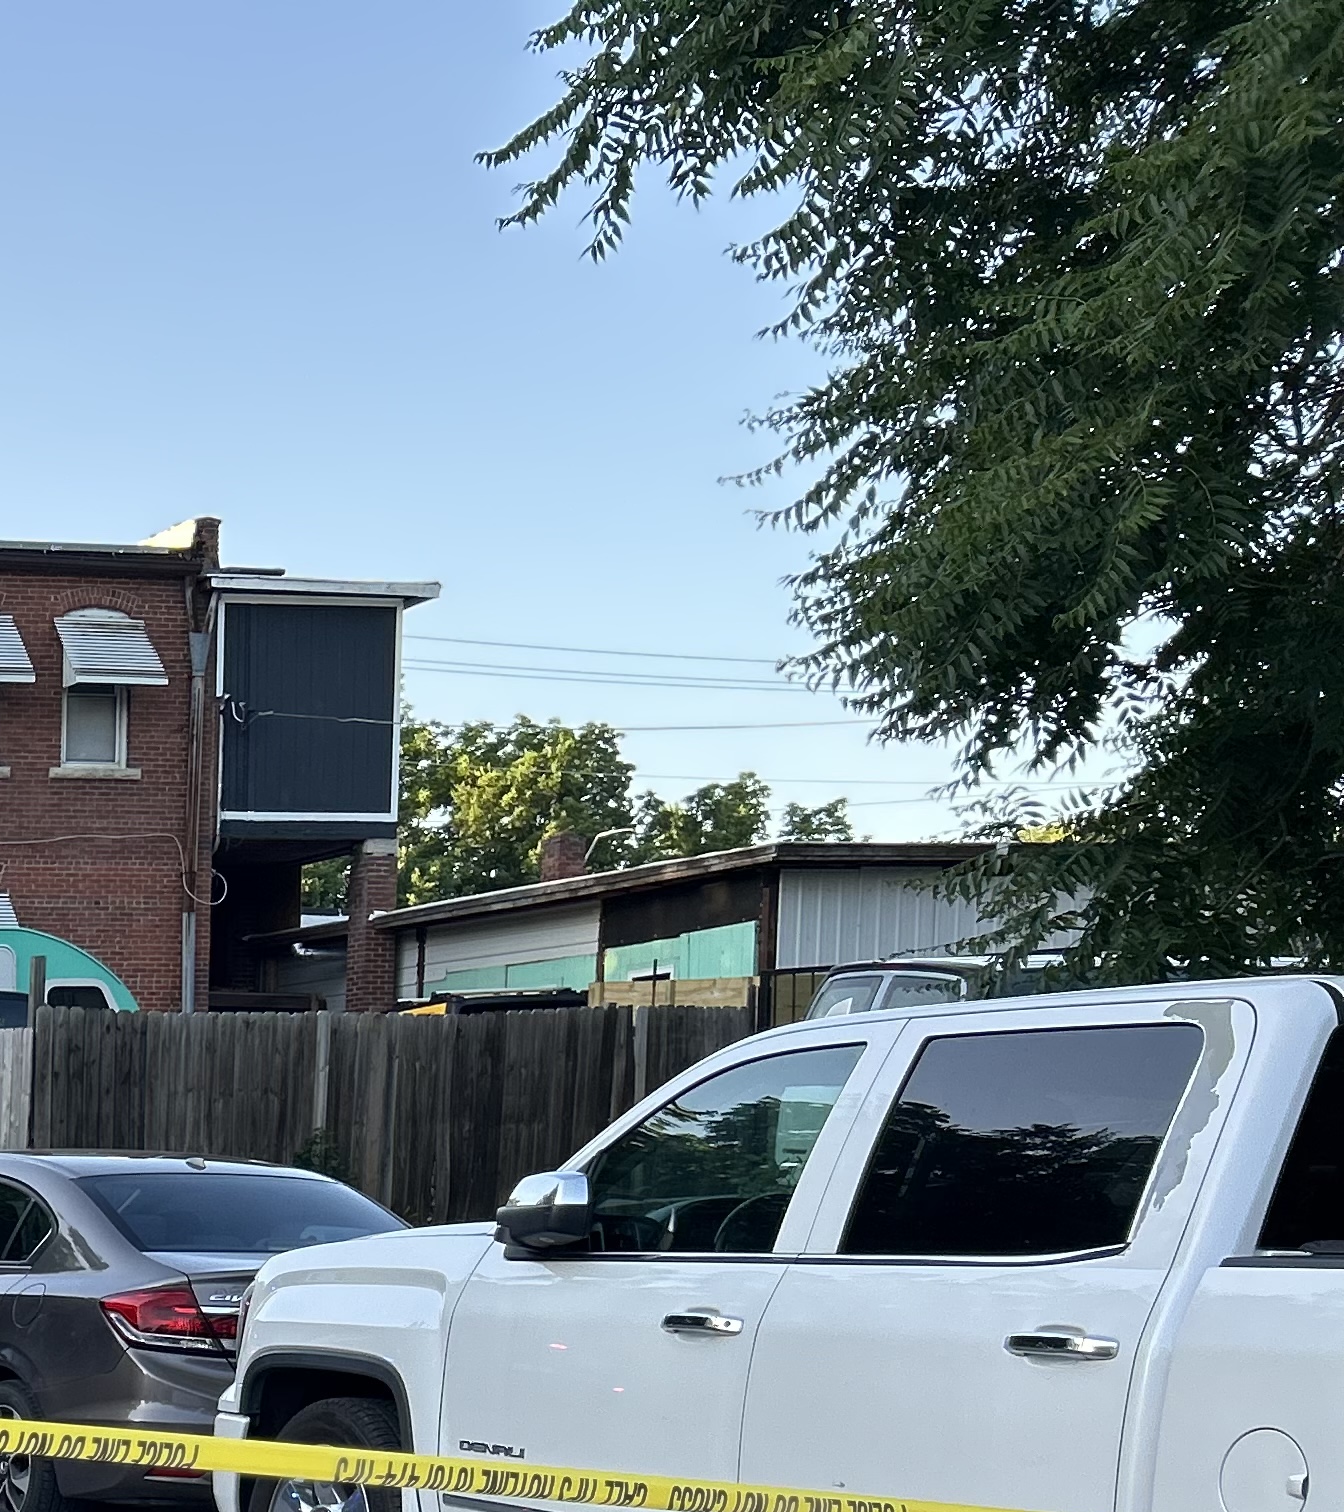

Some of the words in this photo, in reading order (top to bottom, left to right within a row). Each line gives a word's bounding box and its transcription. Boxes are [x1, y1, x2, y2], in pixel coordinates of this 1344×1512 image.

[209, 1294, 243, 1302] CIV
[12, 1431, 55, 1458] NOT
[55, 1434, 86, 1460] DO
[86, 1436, 132, 1464] LINE
[132, 1440, 200, 1469] POLICE
[459, 1440, 525, 1459] DENALI
[475, 1469, 556, 1499] HOTLINE
[598, 1480, 648, 1507] CALL
